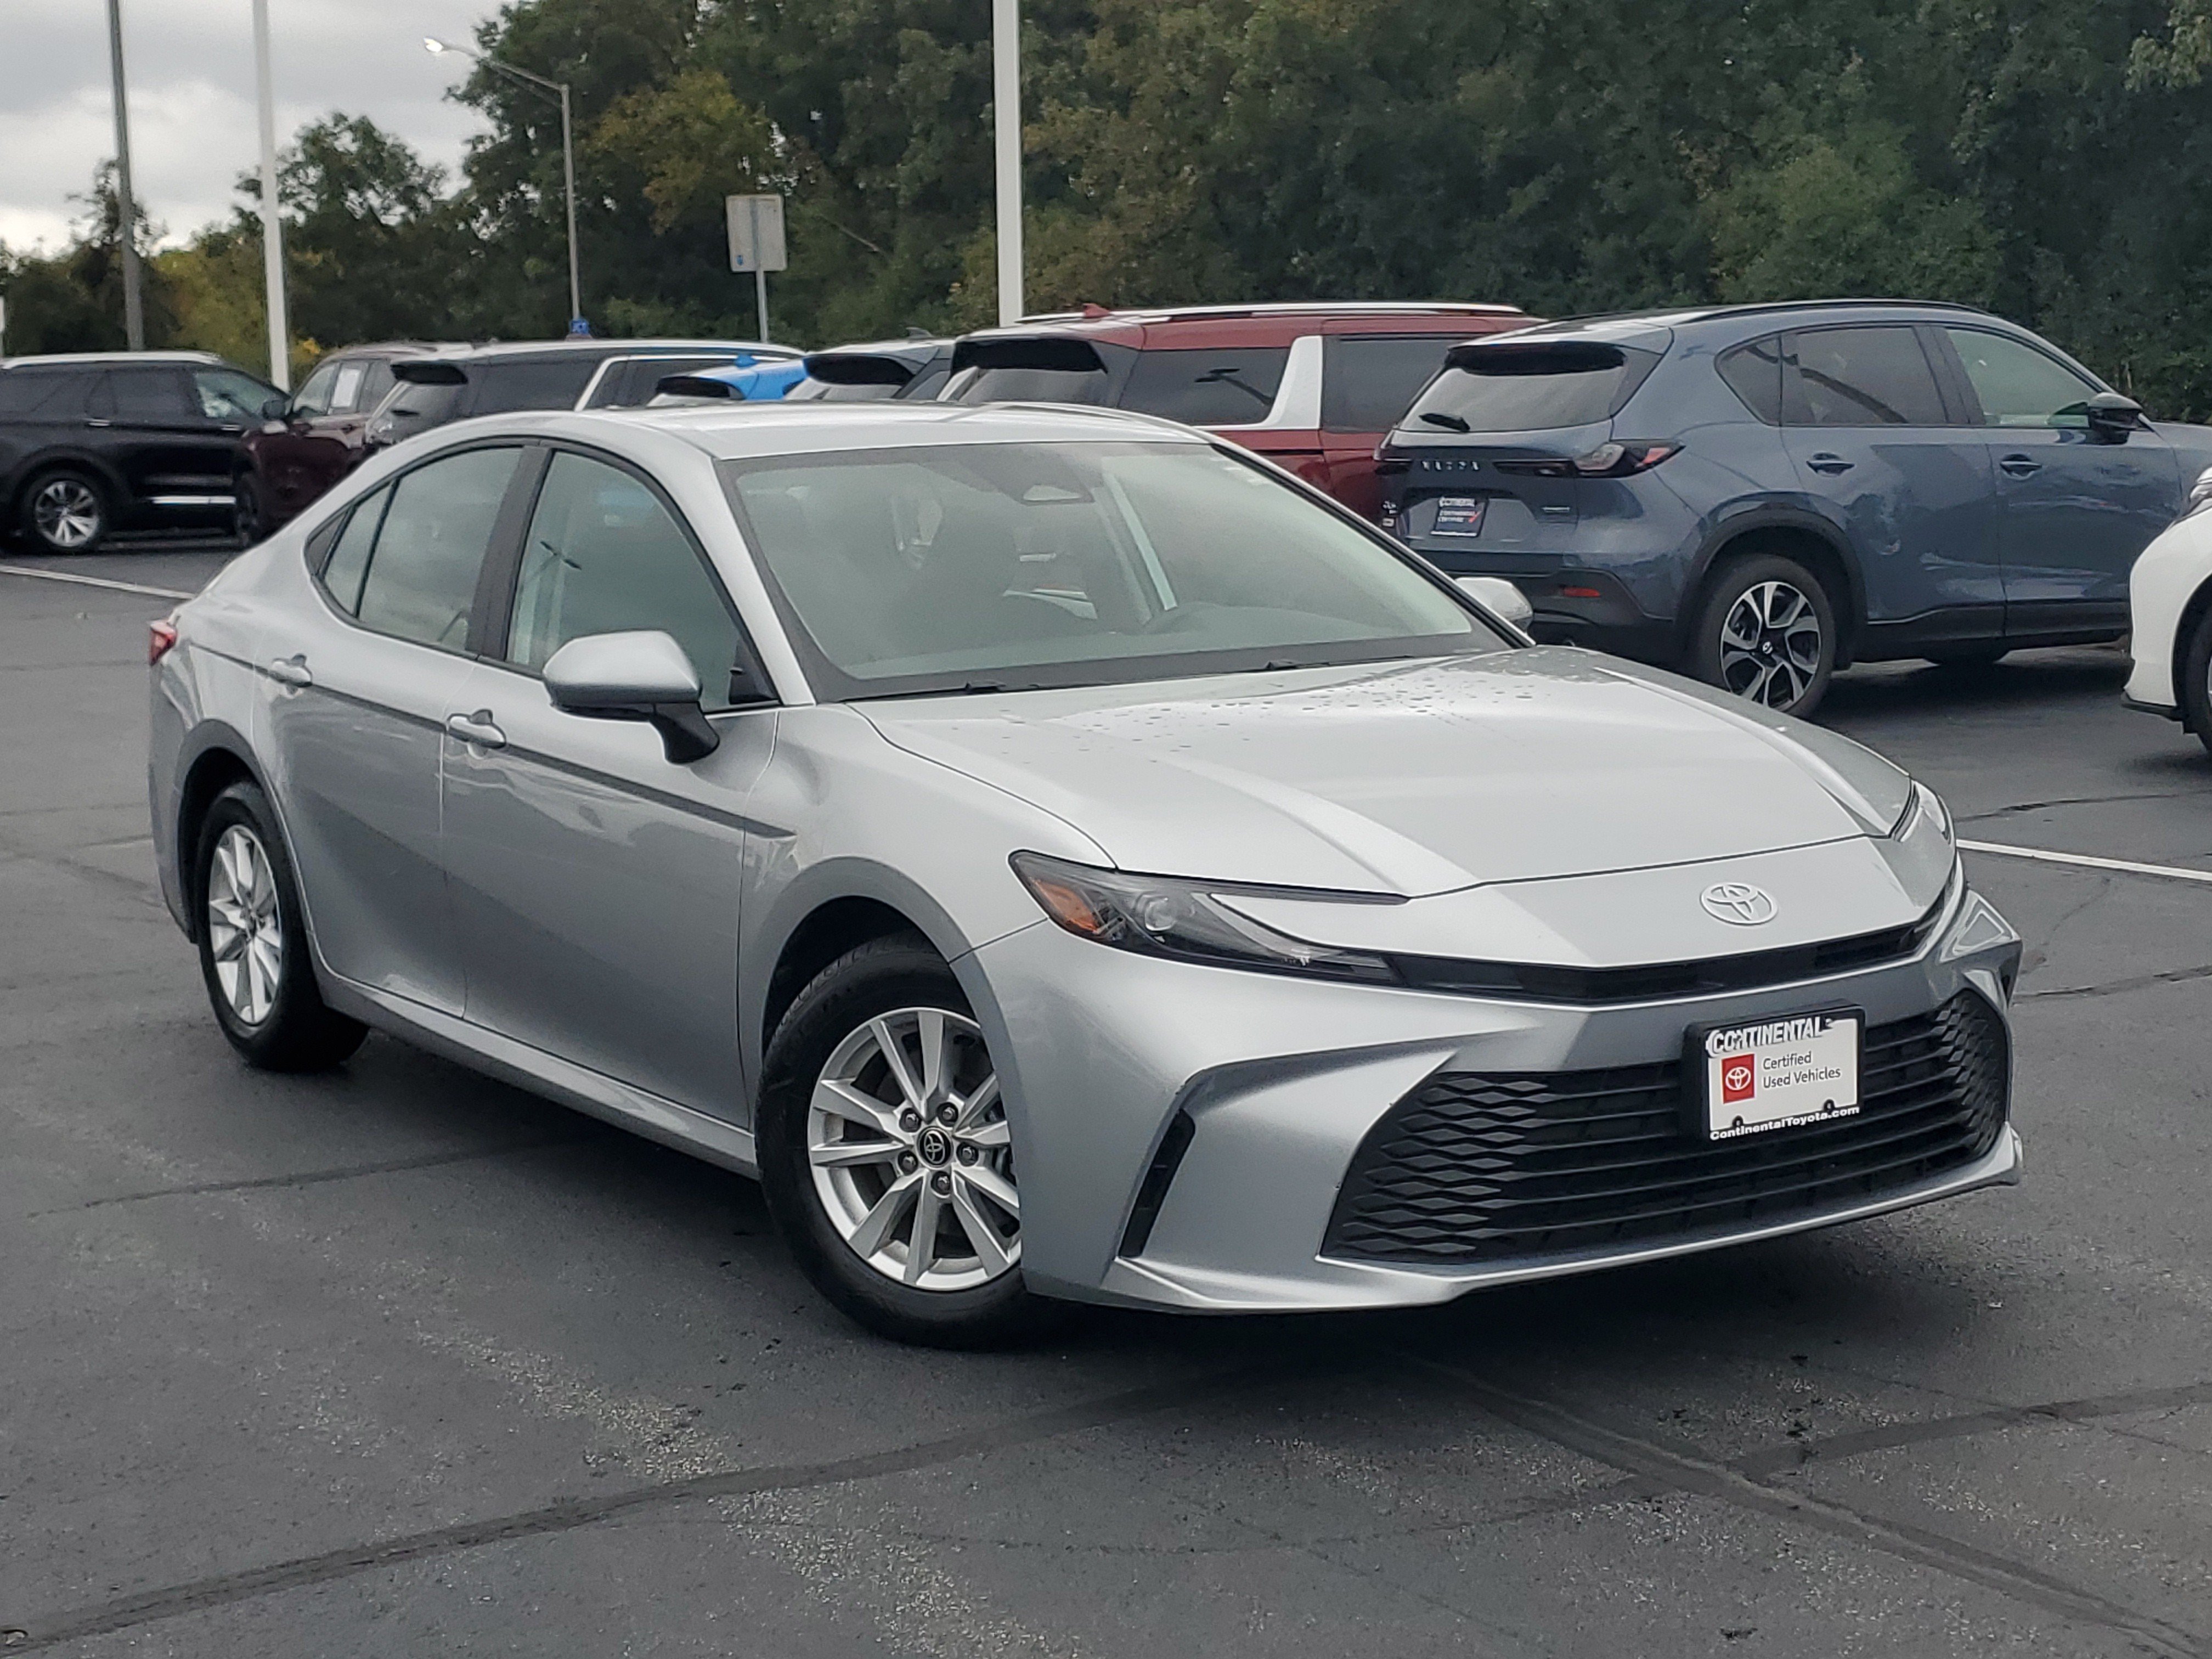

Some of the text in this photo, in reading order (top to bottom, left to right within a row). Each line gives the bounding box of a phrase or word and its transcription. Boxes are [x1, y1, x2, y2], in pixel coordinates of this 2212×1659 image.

[1712, 1017, 1823, 1053] CONTINENTAL
[1763, 1051, 1812, 1070] Certified
[1763, 1066, 1841, 1088] Used Vehicles
[1710, 1106, 1860, 1140] ContinentalToyota.com
